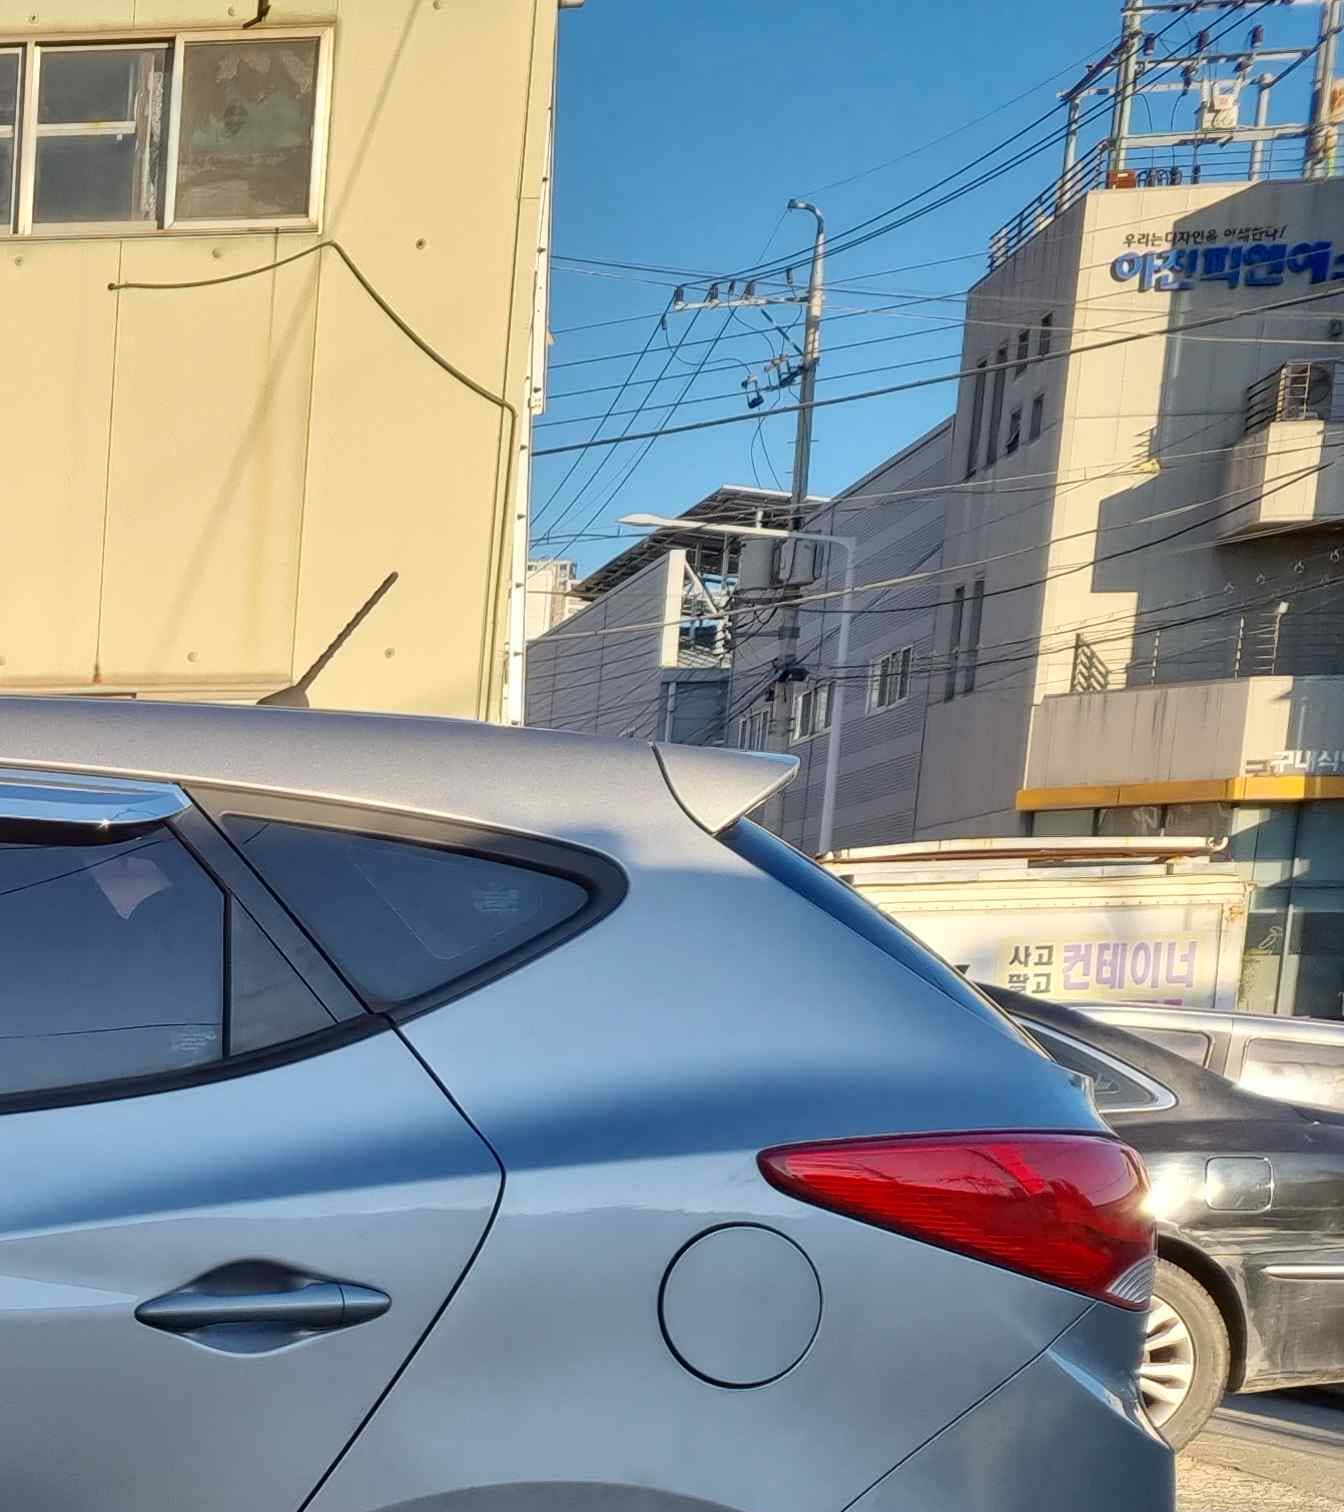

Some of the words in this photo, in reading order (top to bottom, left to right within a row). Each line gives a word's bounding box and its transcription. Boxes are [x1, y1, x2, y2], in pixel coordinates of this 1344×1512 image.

[1270, 749, 1344, 774] 구내식
[1009, 945, 1054, 967] 사고
[1063, 941, 1198, 990] 컨테이너
